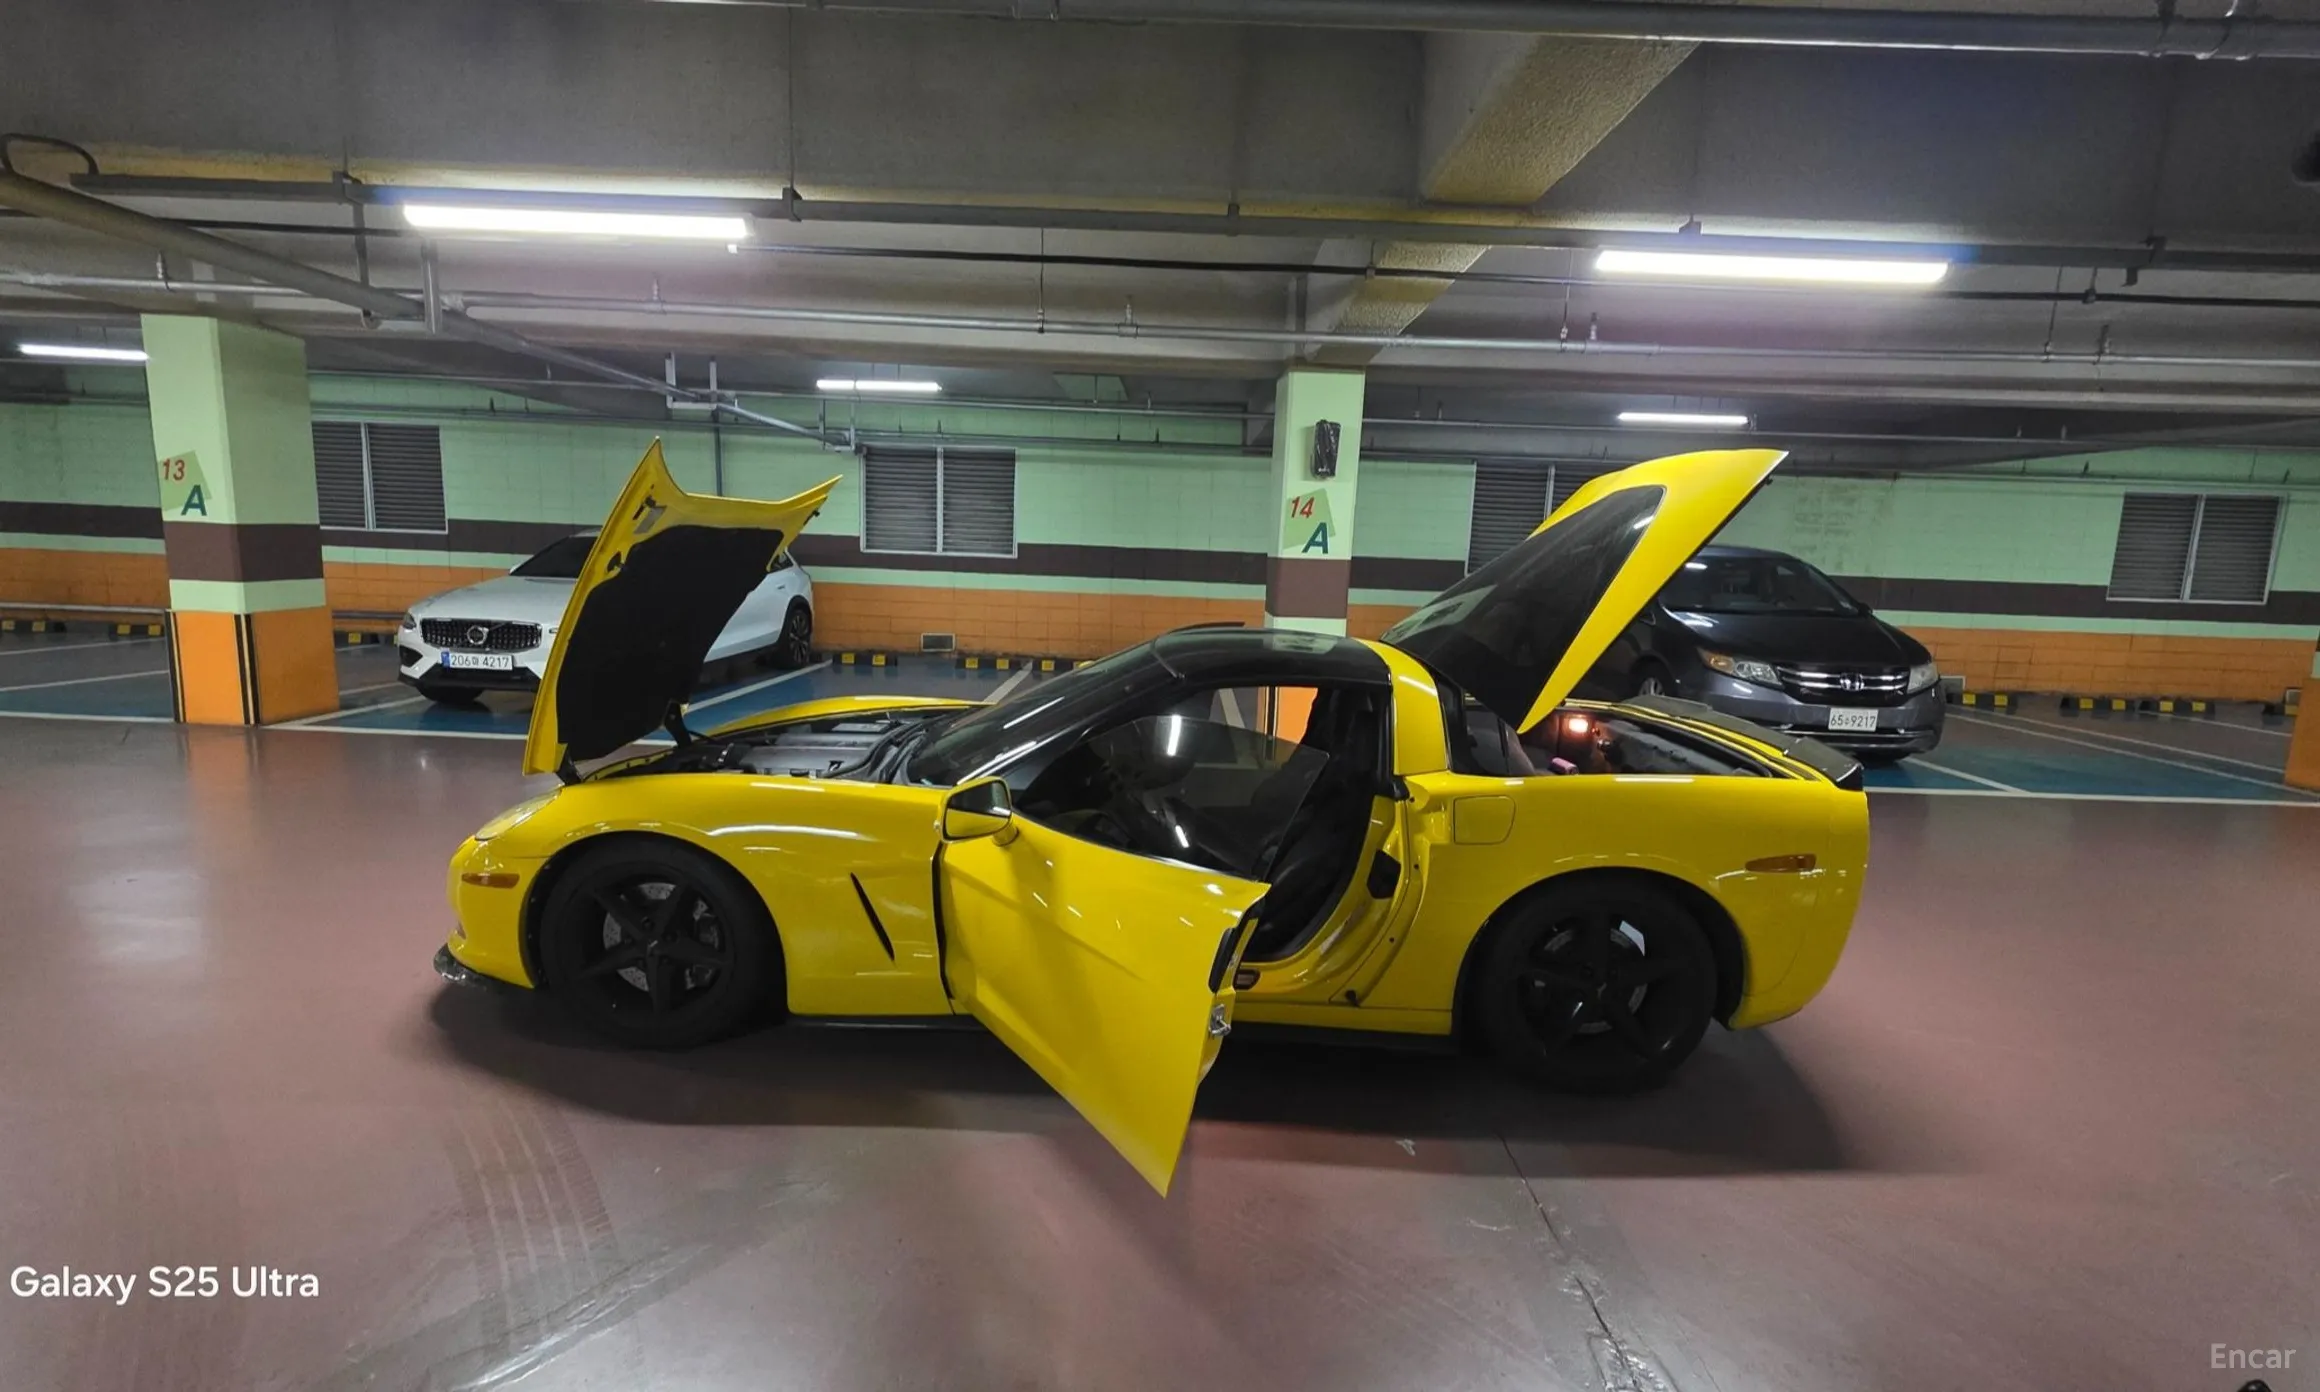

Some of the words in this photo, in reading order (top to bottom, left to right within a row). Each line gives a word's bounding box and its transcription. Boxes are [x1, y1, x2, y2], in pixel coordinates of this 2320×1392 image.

[163, 458, 185, 481] 13
[181, 484, 207, 516] A
[1291, 496, 1315, 518] 14
[1301, 522, 1329, 554] A
[482, 655, 509, 668] 4217
